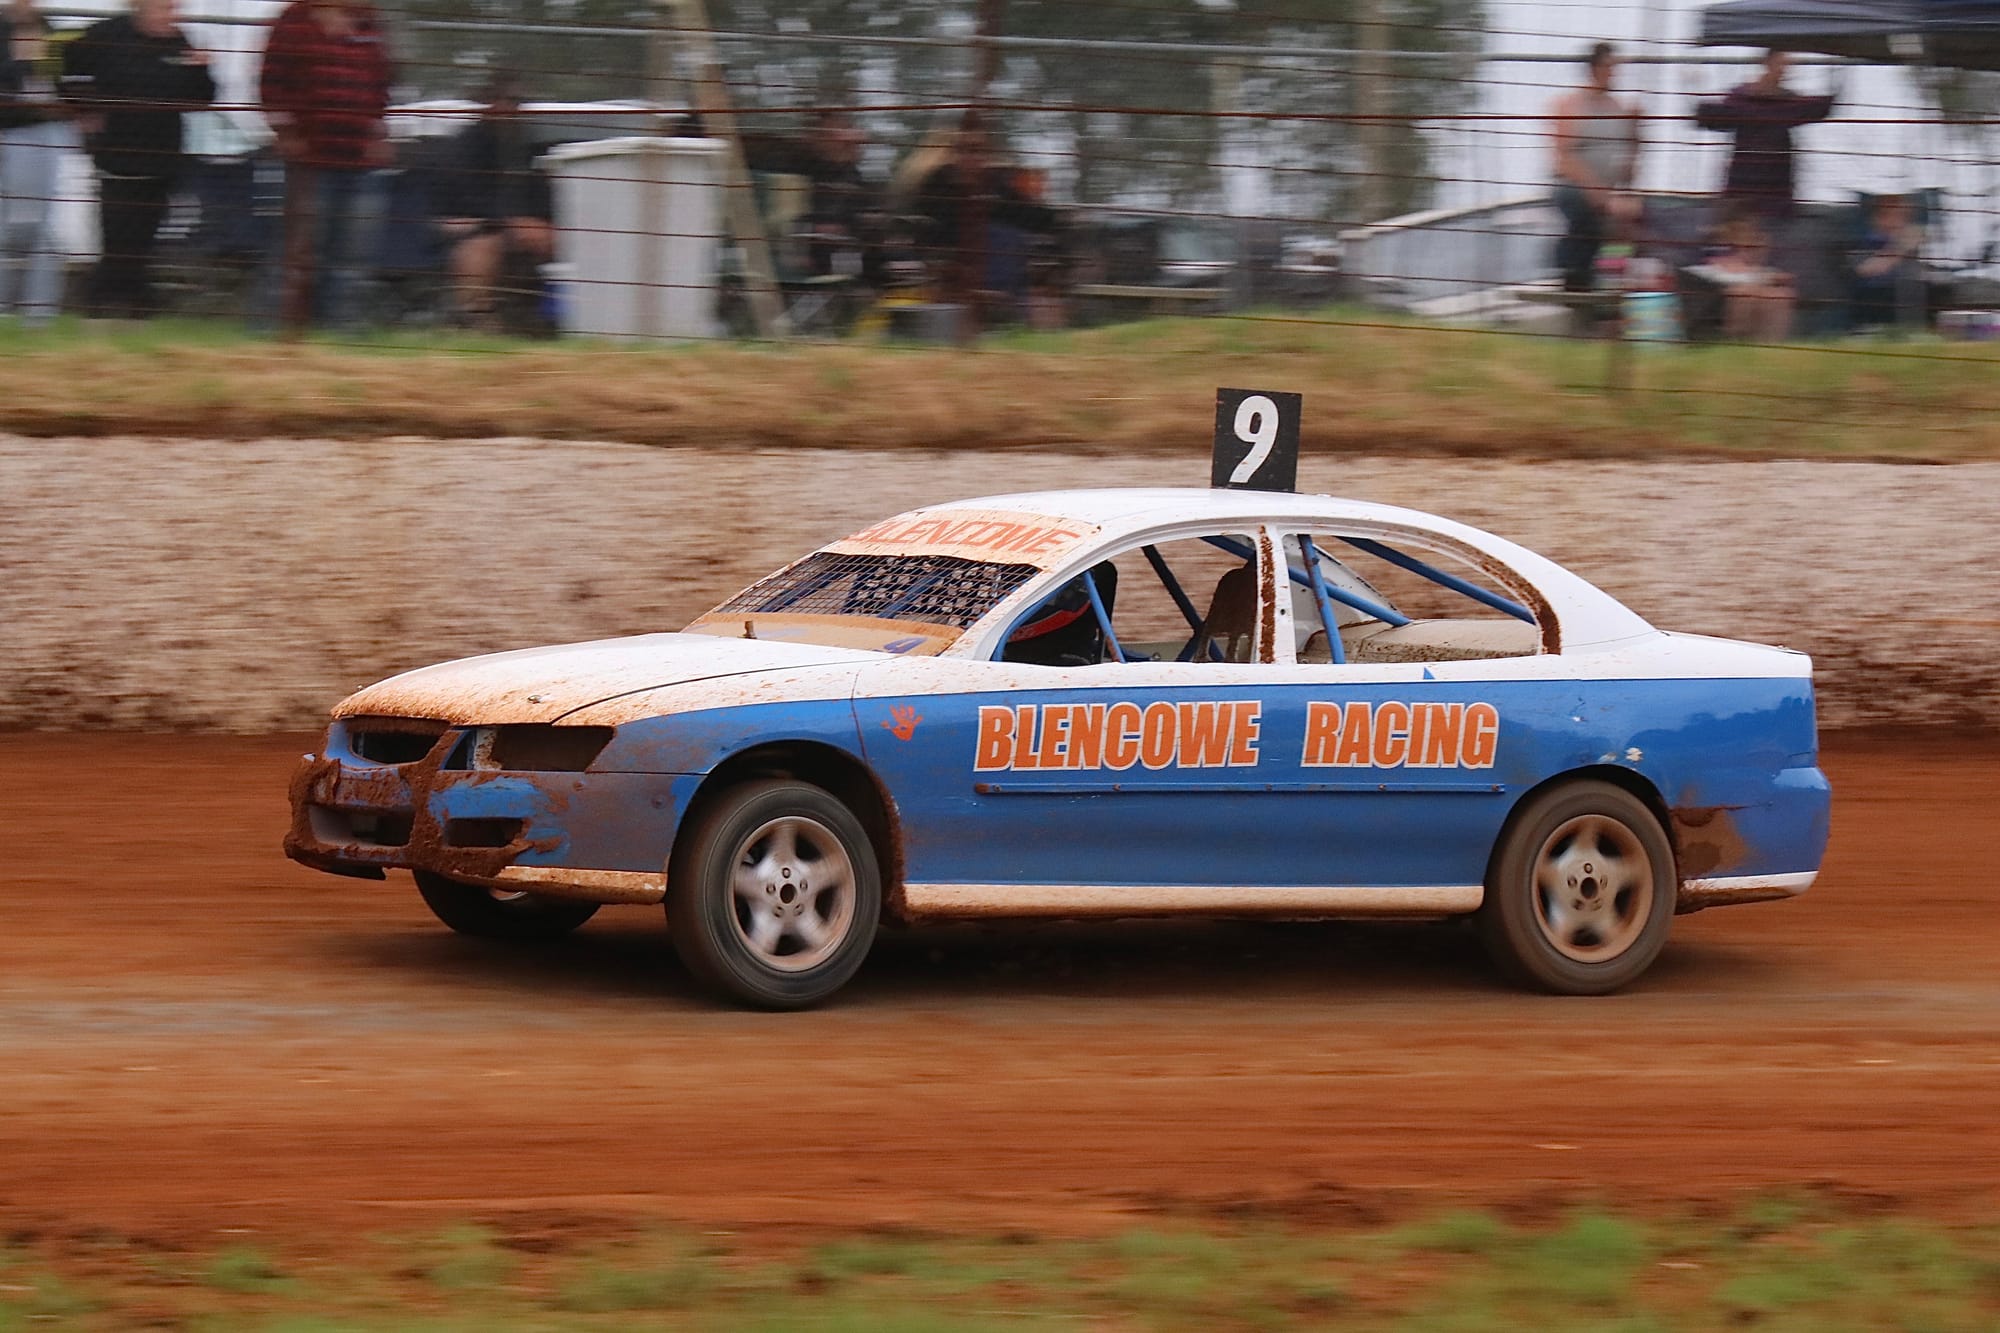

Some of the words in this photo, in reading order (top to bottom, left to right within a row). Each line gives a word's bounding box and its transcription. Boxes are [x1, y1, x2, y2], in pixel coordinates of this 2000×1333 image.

[1229, 395, 1279, 483] 9
[973, 700, 1261, 771] BLENCOWE
[1300, 701, 1499, 769] RACING
